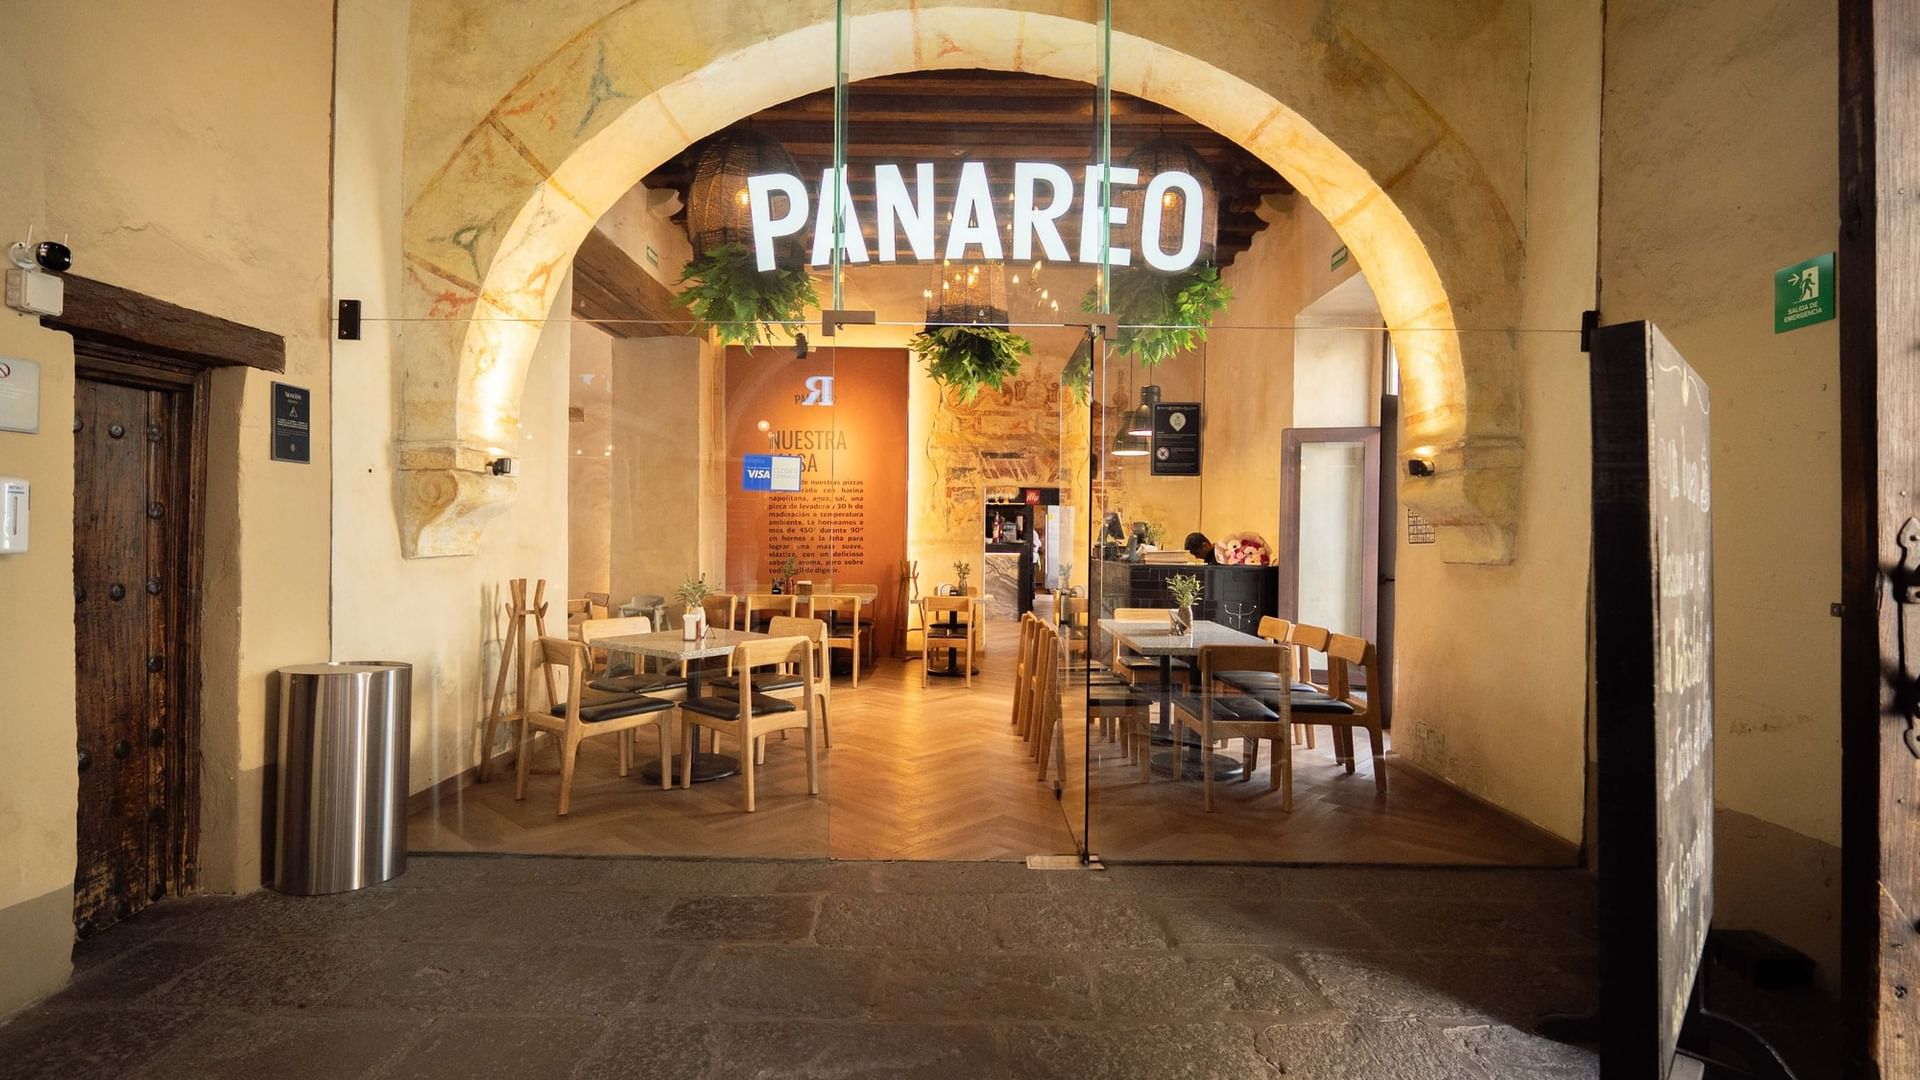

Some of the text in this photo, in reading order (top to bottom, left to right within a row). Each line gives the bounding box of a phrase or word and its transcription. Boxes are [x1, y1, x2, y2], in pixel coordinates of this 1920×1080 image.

[747, 161, 1204, 272] PANAREO
[1788, 304, 1809, 315] SALIDA
[1783, 307, 1822, 322] EMERGENCIA
[769, 430, 847, 450] NUESTRA
[746, 469, 770, 479] VISA
[842, 479, 864, 487] pizzas
[768, 503, 787, 511] pizca
[789, 502, 798, 510] de
[799, 502, 830, 510] levadura
[854, 502, 864, 510] de
[820, 511, 864, 519] temperatura
[768, 543, 790, 551] lograr
[832, 550, 864, 558] delicioso
[844, 559, 864, 567] sobre
